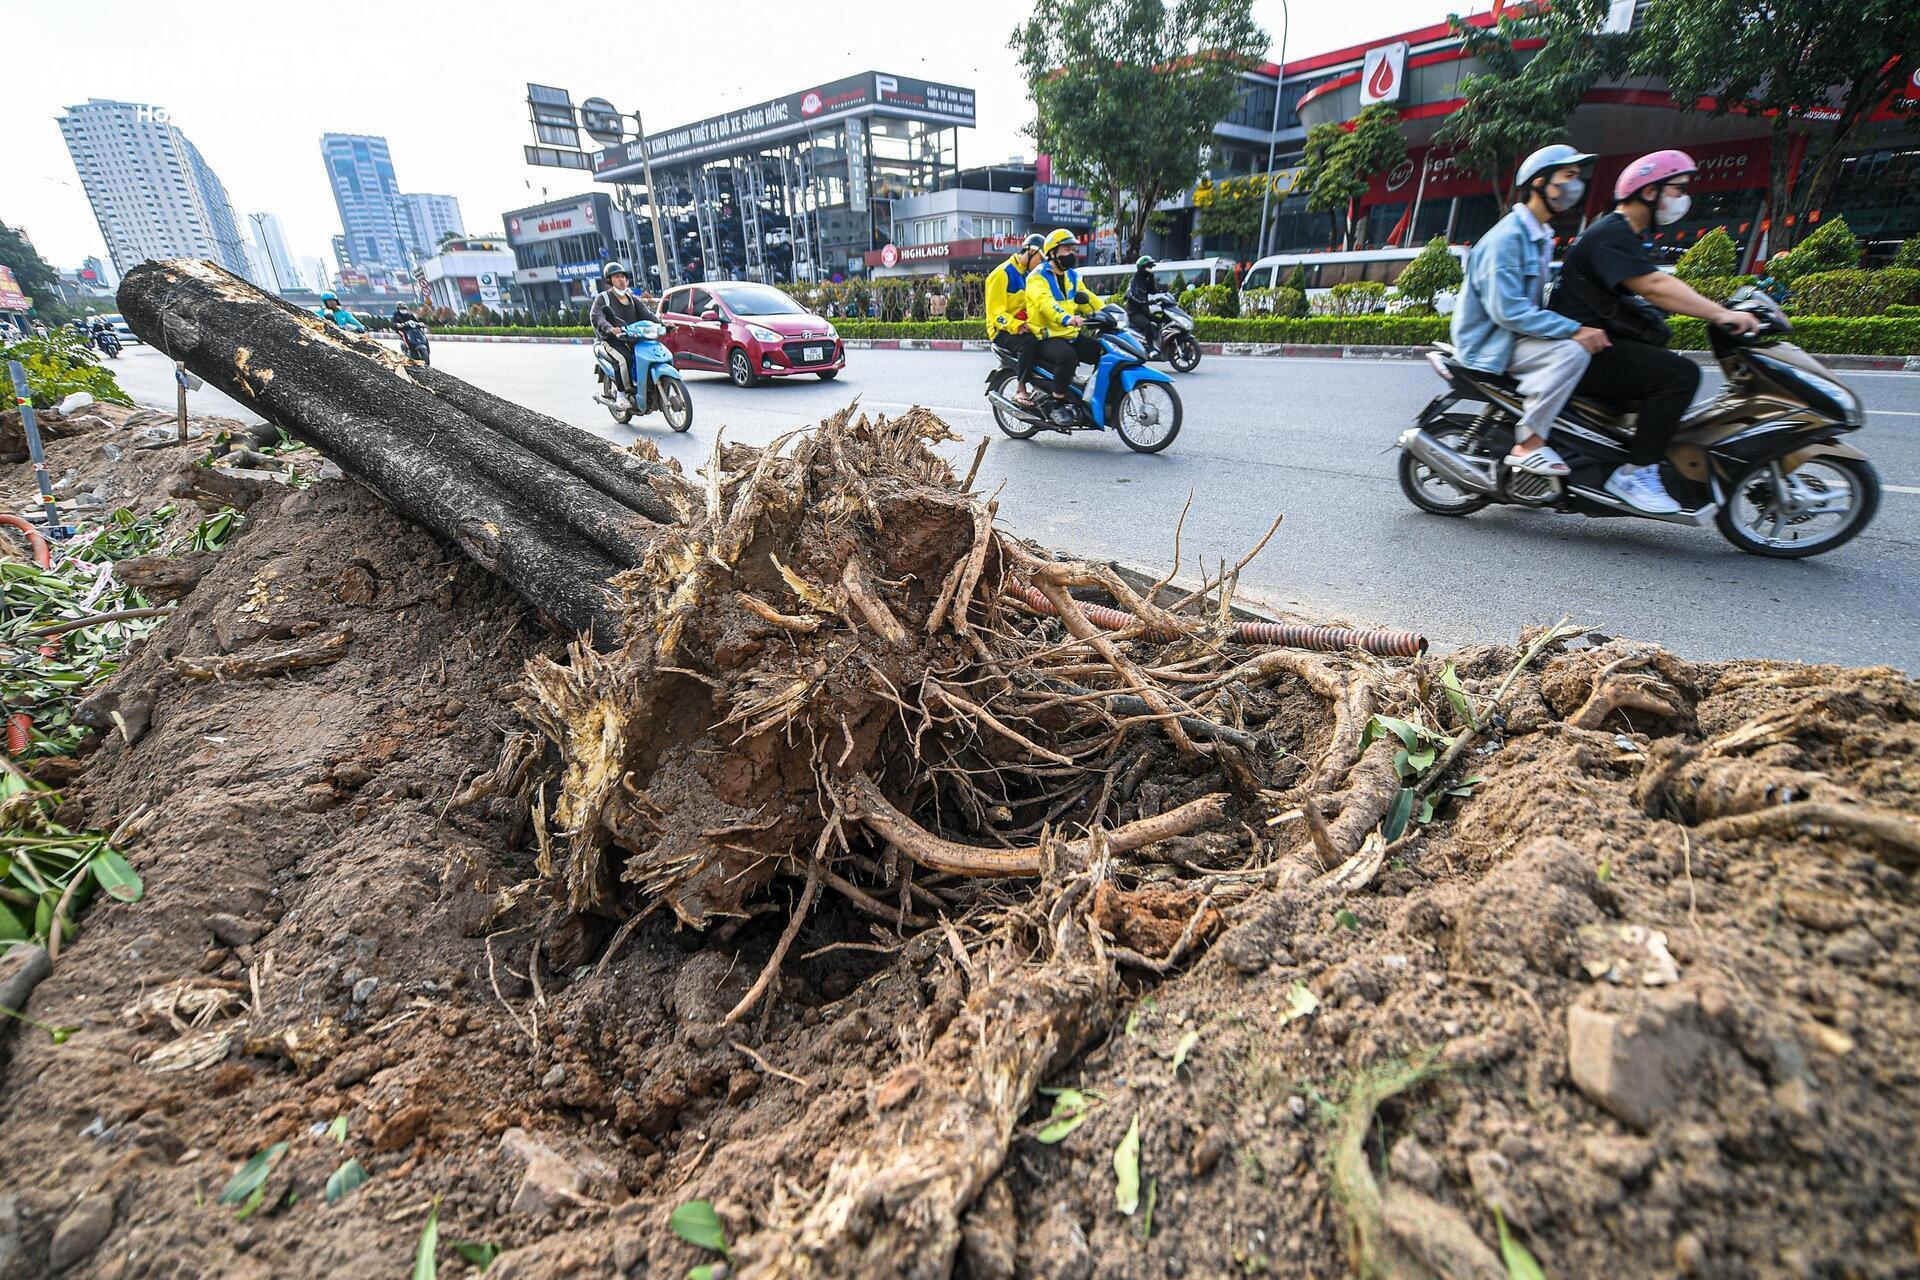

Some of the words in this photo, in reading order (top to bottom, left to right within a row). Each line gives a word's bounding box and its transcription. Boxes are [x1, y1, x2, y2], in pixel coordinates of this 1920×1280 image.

[651, 136, 668, 153] KINH
[667, 132, 690, 150] DOANH
[730, 115, 741, 134] XE
[741, 109, 764, 131] SÔNG
[1696, 154, 1748, 169] rvice
[901, 244, 950, 260] HIGHLANDS
